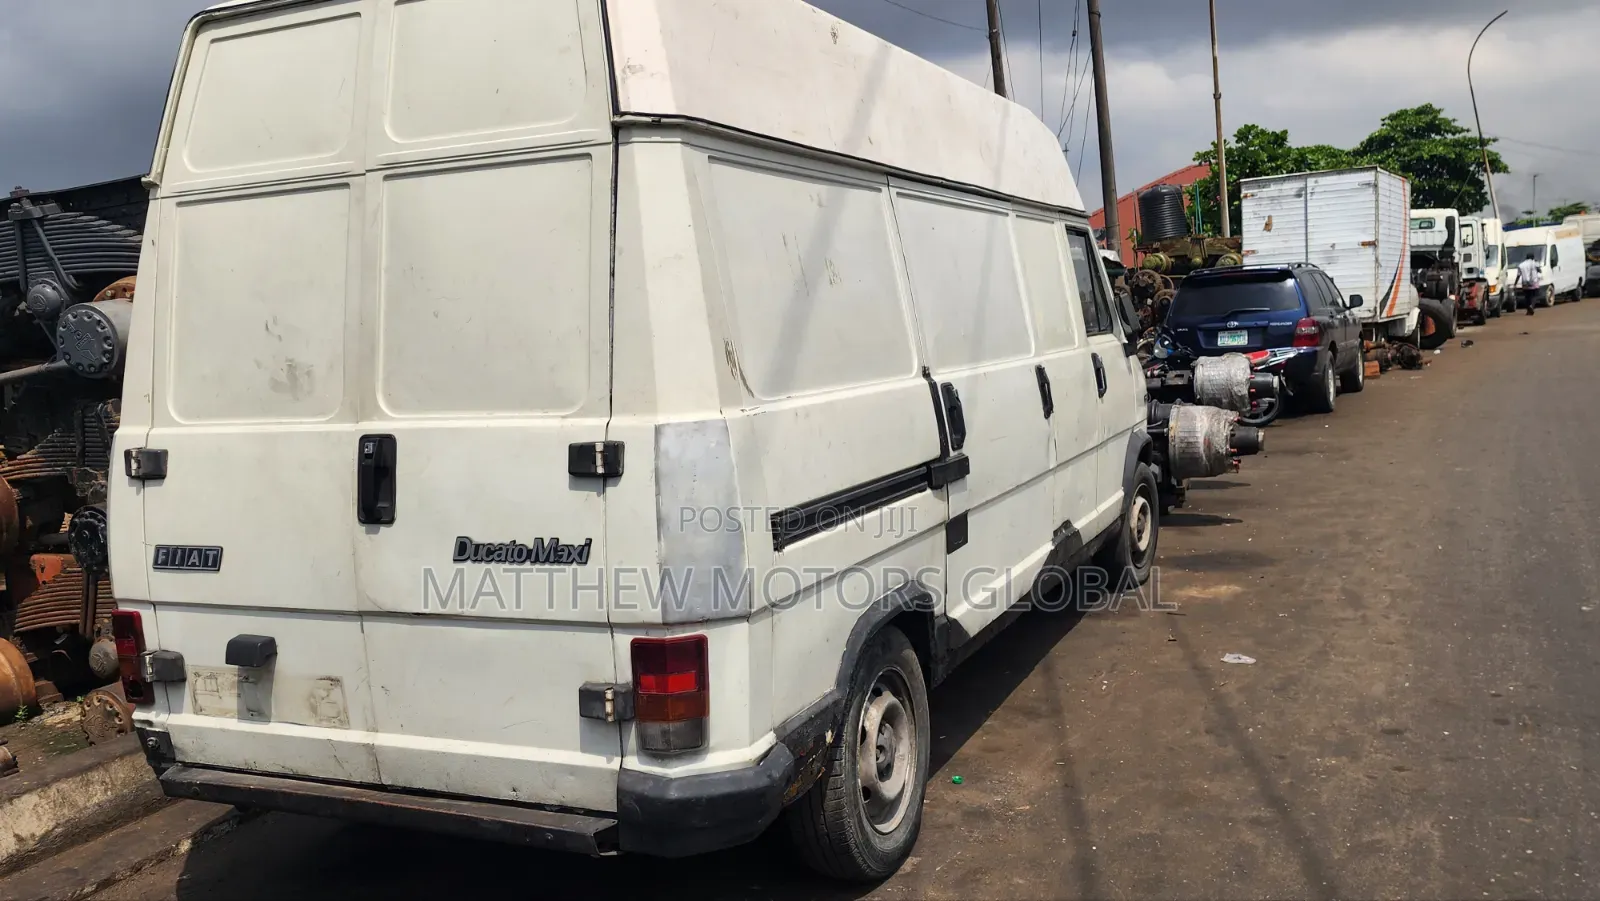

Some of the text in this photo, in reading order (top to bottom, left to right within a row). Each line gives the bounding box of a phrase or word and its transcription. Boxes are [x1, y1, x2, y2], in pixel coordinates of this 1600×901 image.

[155, 547, 219, 568] FIAT
[453, 536, 592, 564] Ducato Maxi
